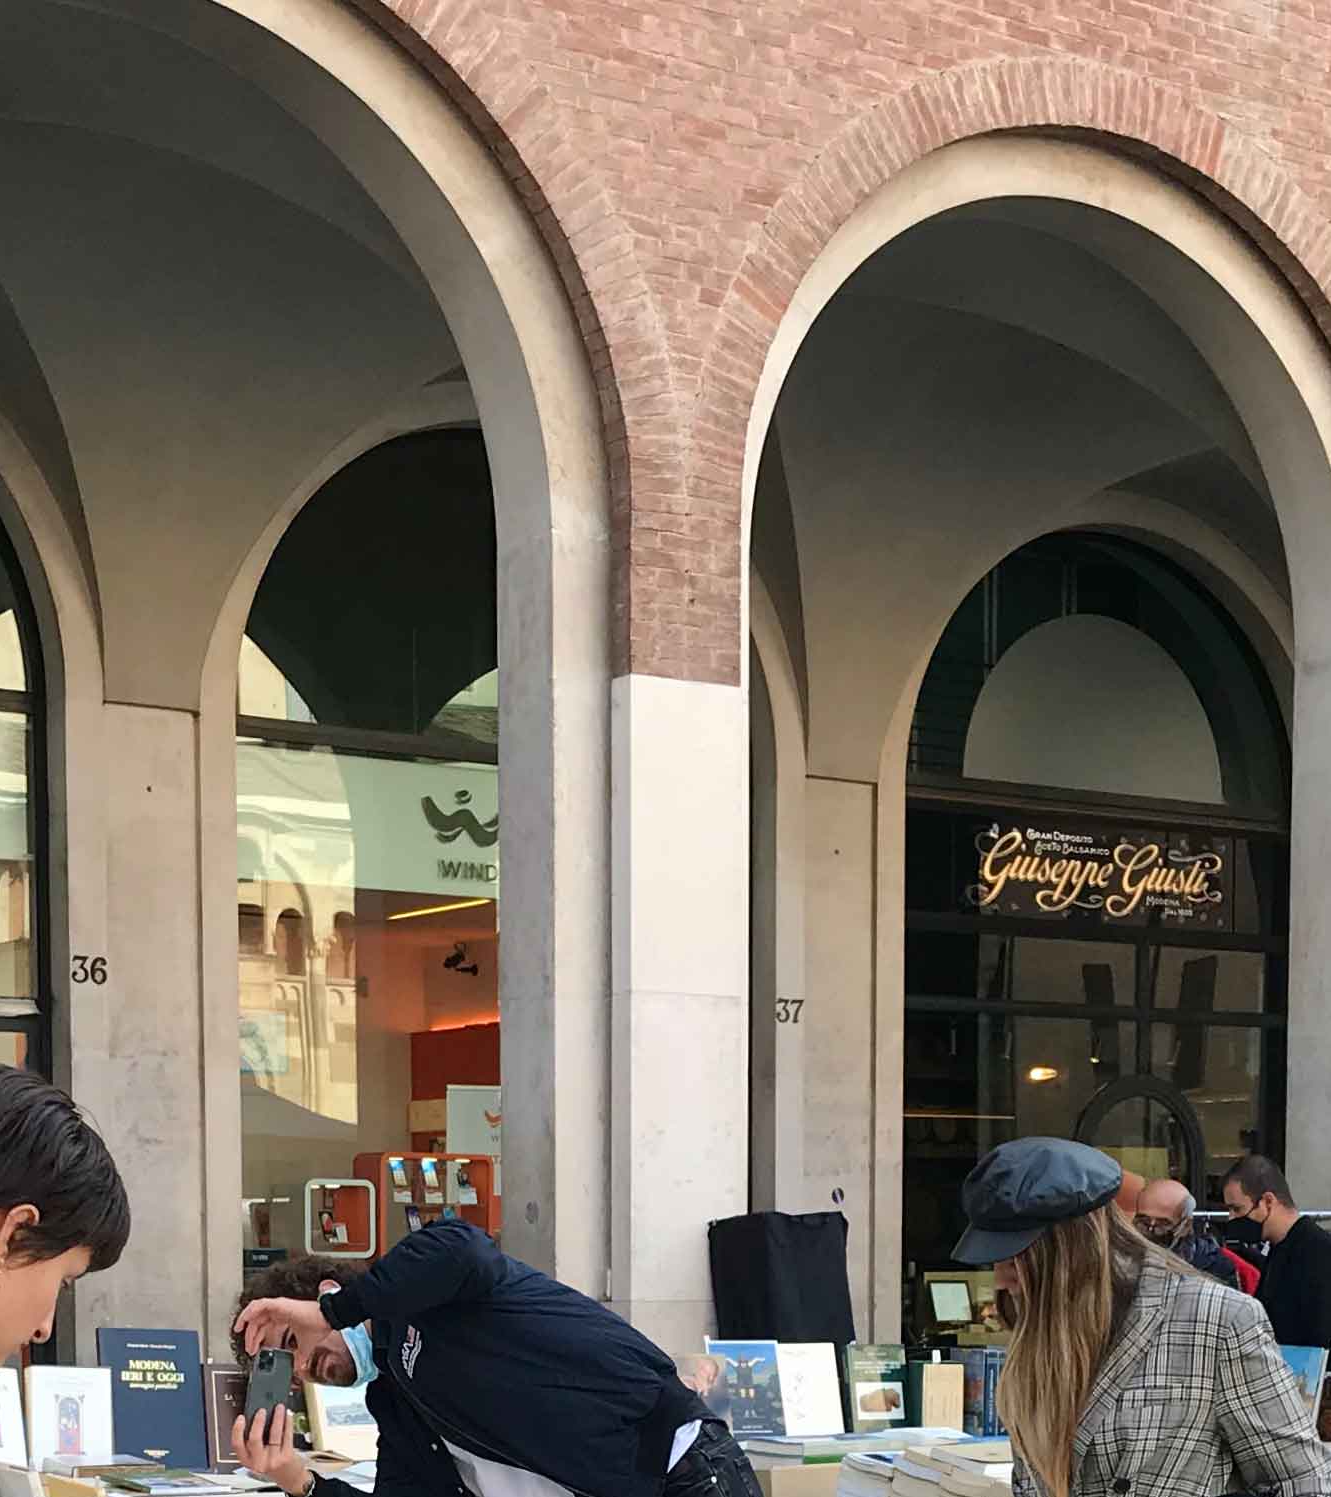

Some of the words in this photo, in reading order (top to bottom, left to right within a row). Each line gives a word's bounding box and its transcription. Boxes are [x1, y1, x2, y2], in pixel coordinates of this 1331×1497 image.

[1062, 843, 1110, 857] BALSAMICO
[437, 859, 498, 882] WIND
[977, 830, 1114, 912] Giuseppe
[1106, 843, 1217, 918] Giusti
[71, 955, 108, 985] 36
[775, 998, 804, 1024] 37
[128, 1359, 176, 1372] MODENA
[156, 1372, 186, 1383] OGGI
